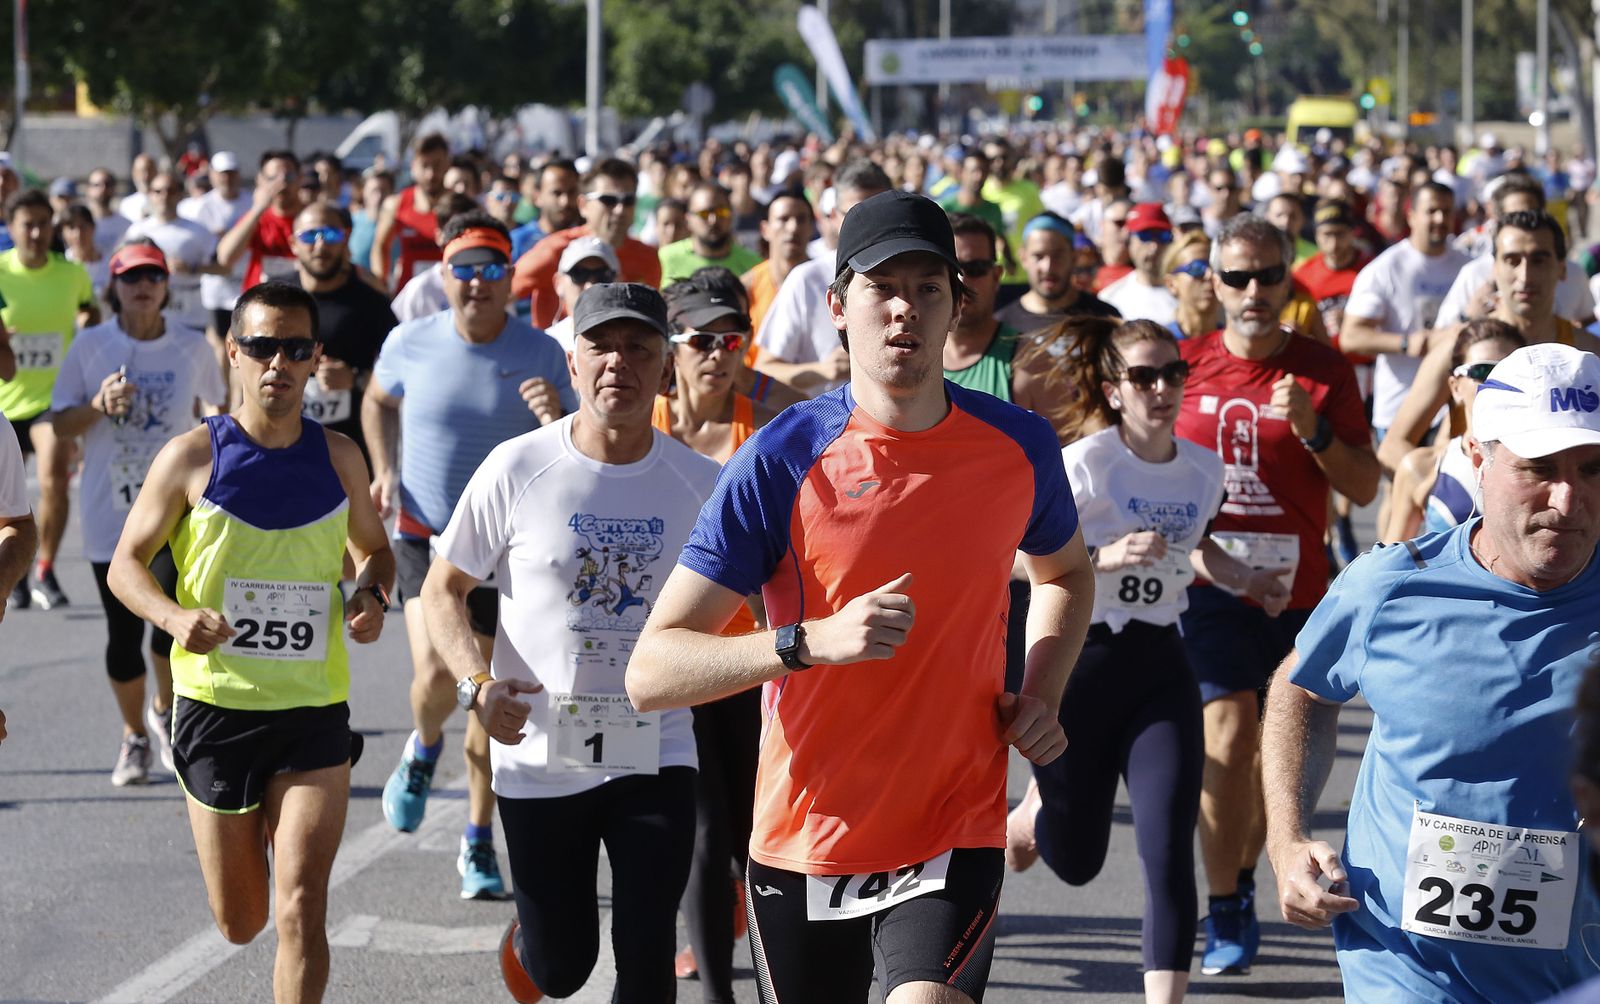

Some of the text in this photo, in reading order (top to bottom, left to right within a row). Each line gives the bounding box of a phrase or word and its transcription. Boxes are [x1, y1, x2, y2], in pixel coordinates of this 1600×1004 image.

[1118, 575, 1163, 604] 89
[232, 618, 314, 651] 259
[585, 732, 604, 763] 1
[1433, 820, 1486, 837] CARRERA
[1488, 829, 1504, 839] DE
[1507, 832, 1521, 841] LA
[1524, 834, 1567, 846] PRENSA
[1472, 840, 1501, 856] APM
[821, 862, 925, 908] 742
[1415, 876, 1539, 936] 235
